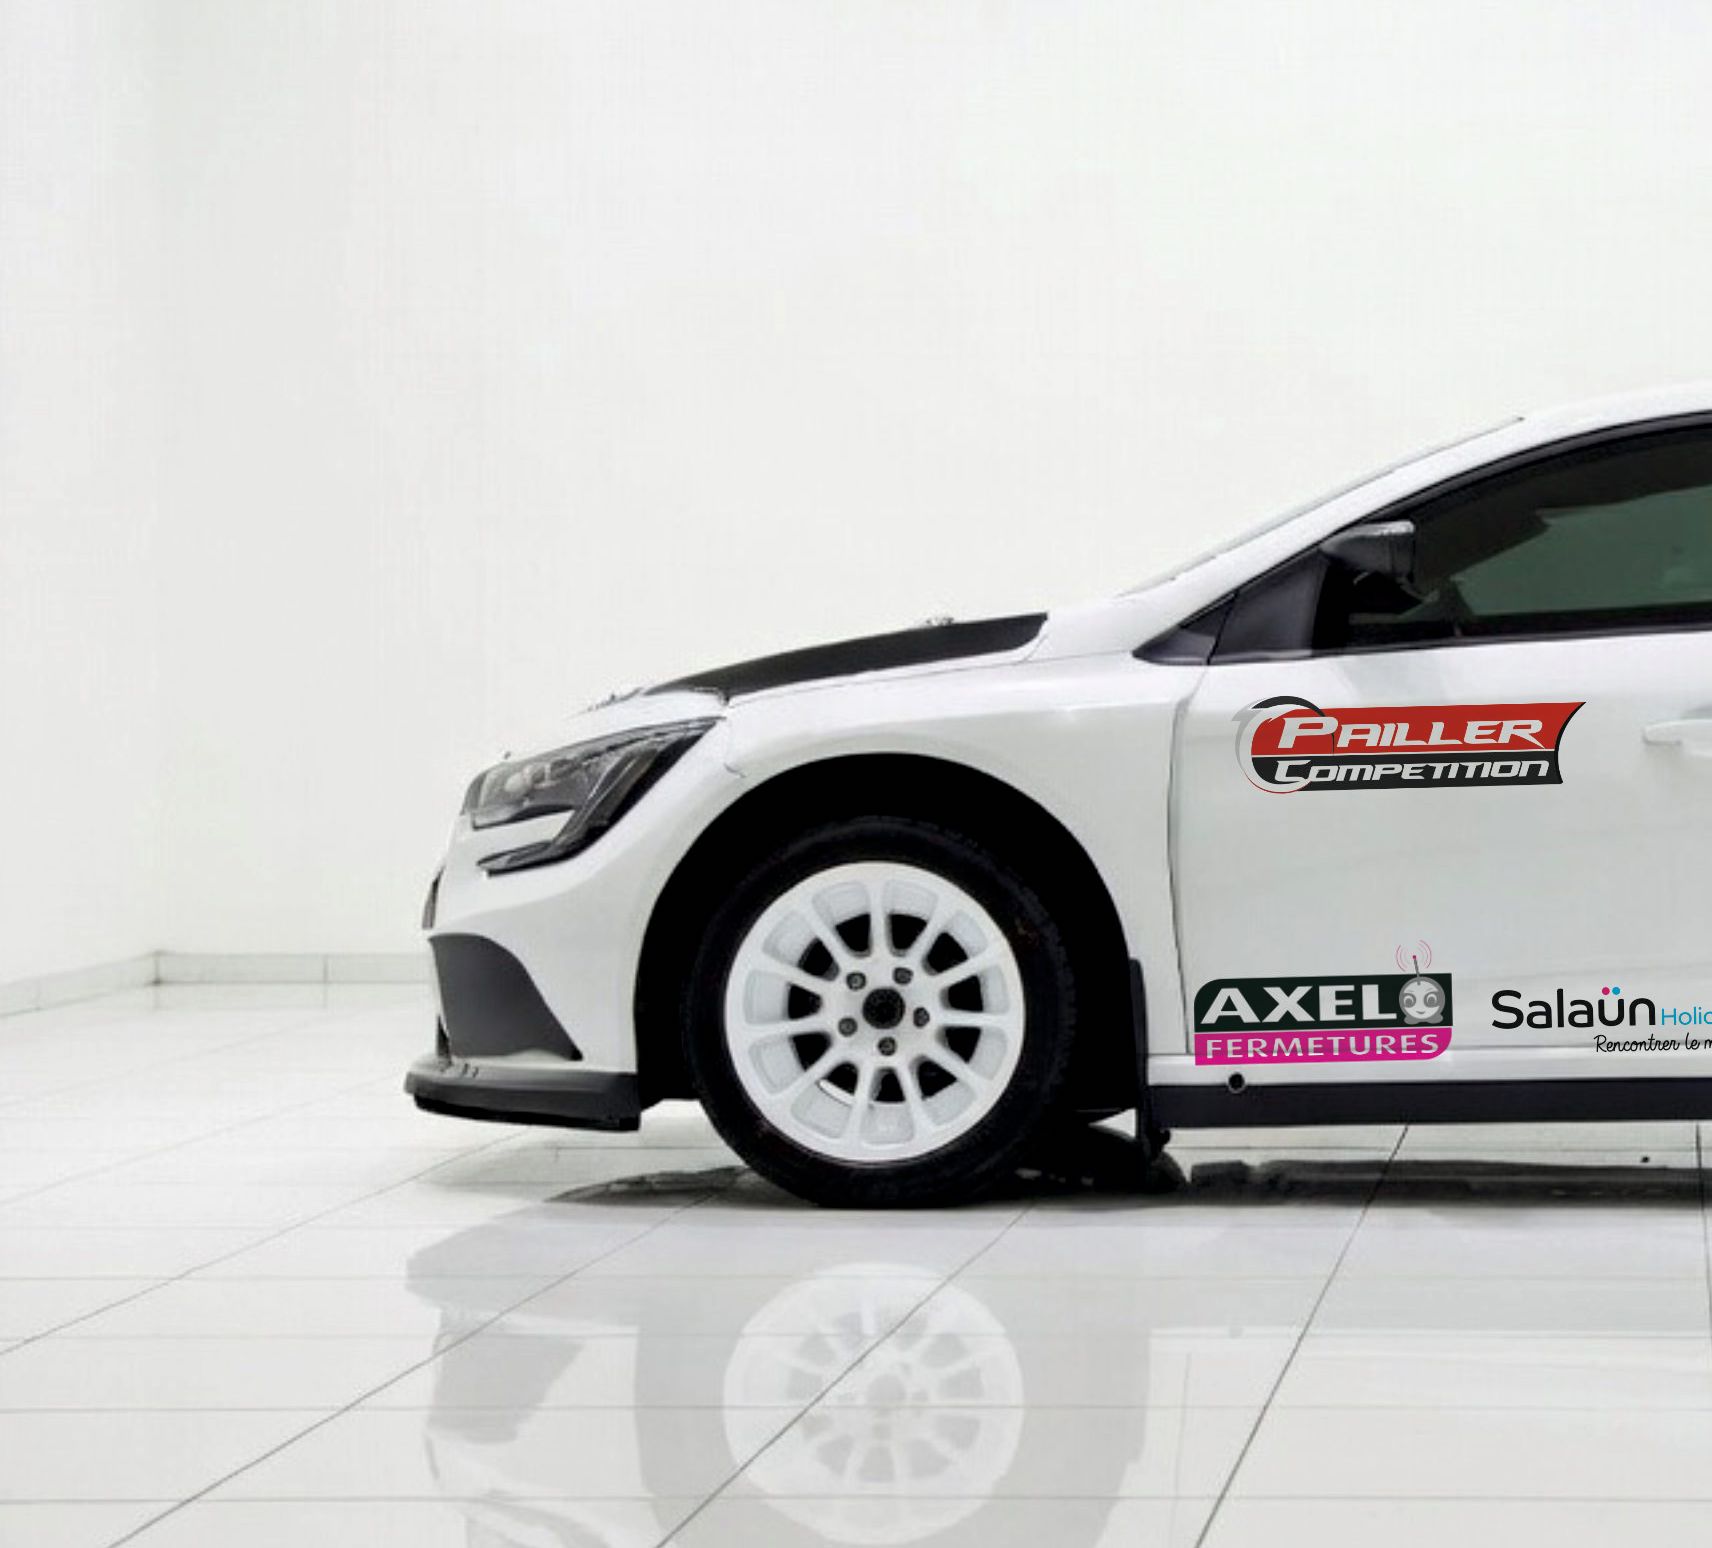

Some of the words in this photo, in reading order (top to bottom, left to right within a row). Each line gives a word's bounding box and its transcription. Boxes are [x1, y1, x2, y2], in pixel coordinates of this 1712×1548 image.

[1491, 986, 1656, 1029] Salaün
[1205, 1032, 1440, 1059] FERMETURES
[1594, 1033, 1680, 1053] Rencontrer
[1684, 1032, 1701, 1051] le
